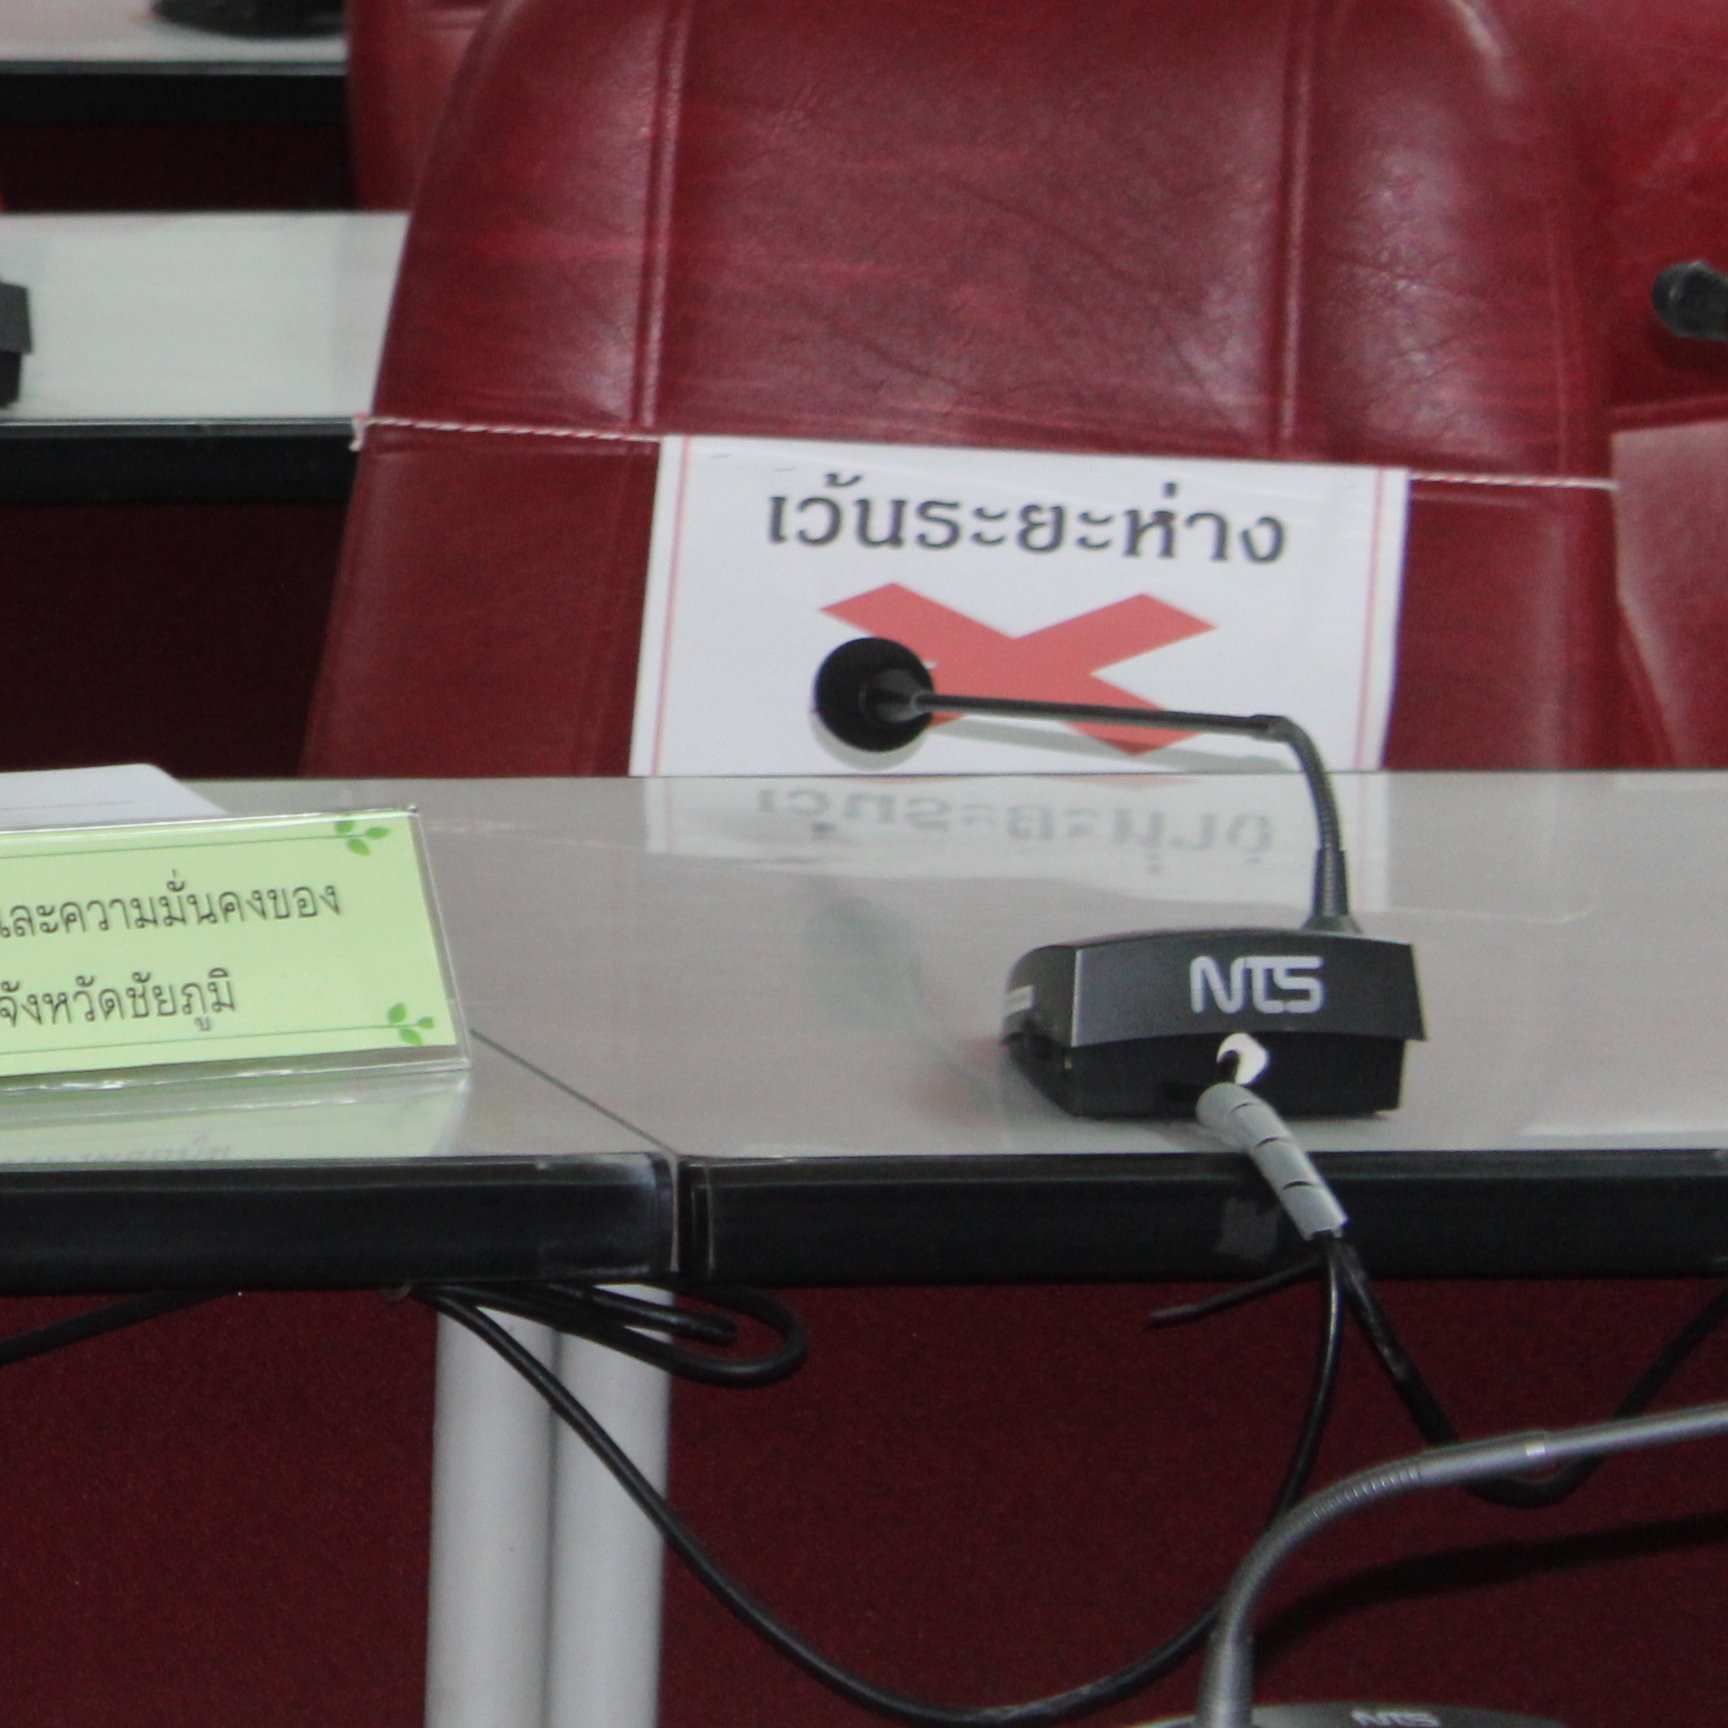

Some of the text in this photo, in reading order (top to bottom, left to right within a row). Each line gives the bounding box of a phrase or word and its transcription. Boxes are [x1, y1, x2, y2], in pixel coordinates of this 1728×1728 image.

[767, 470, 1288, 565] เว้นระยะห่าง
[1188, 955, 1324, 1015] NTS
